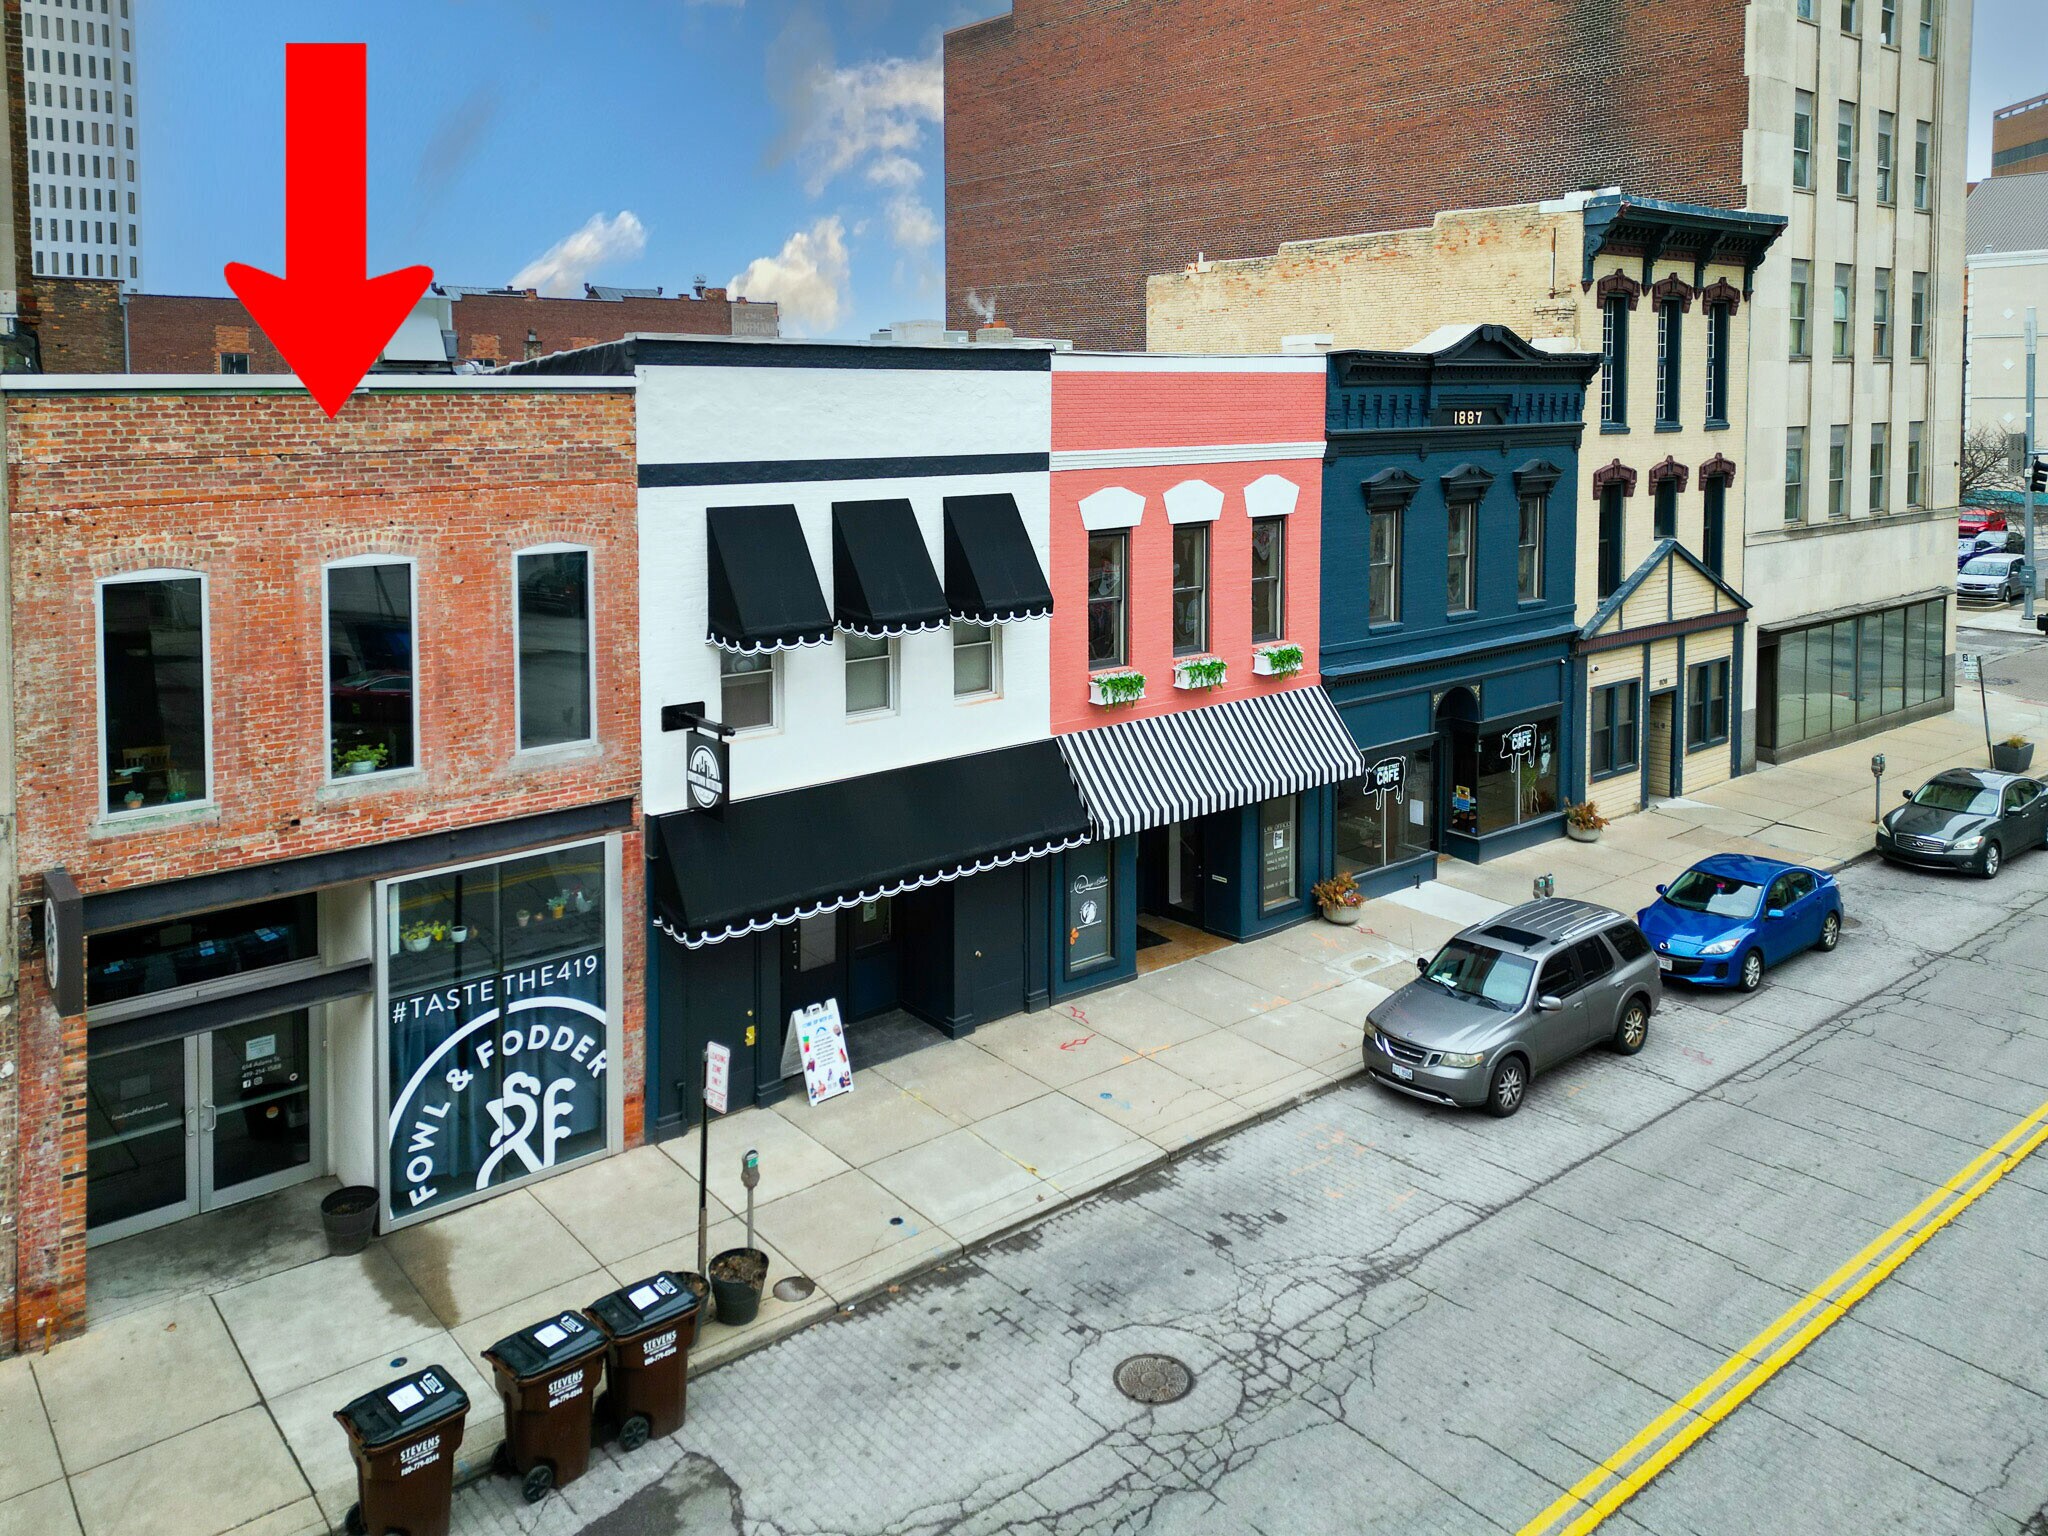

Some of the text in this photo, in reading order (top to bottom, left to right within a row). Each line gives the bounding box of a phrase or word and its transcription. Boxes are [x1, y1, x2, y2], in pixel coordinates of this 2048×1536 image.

[1454, 410, 1483, 425] 1887
[1511, 734, 1532, 751] CAFE
[1376, 767, 1400, 786] CAFE
[406, 1024, 607, 1207] FOWL & FODDER
[643, 1330, 677, 1352] STEVENS
[548, 1369, 584, 1393] STEVENS
[400, 1435, 440, 1461] STEVENS
